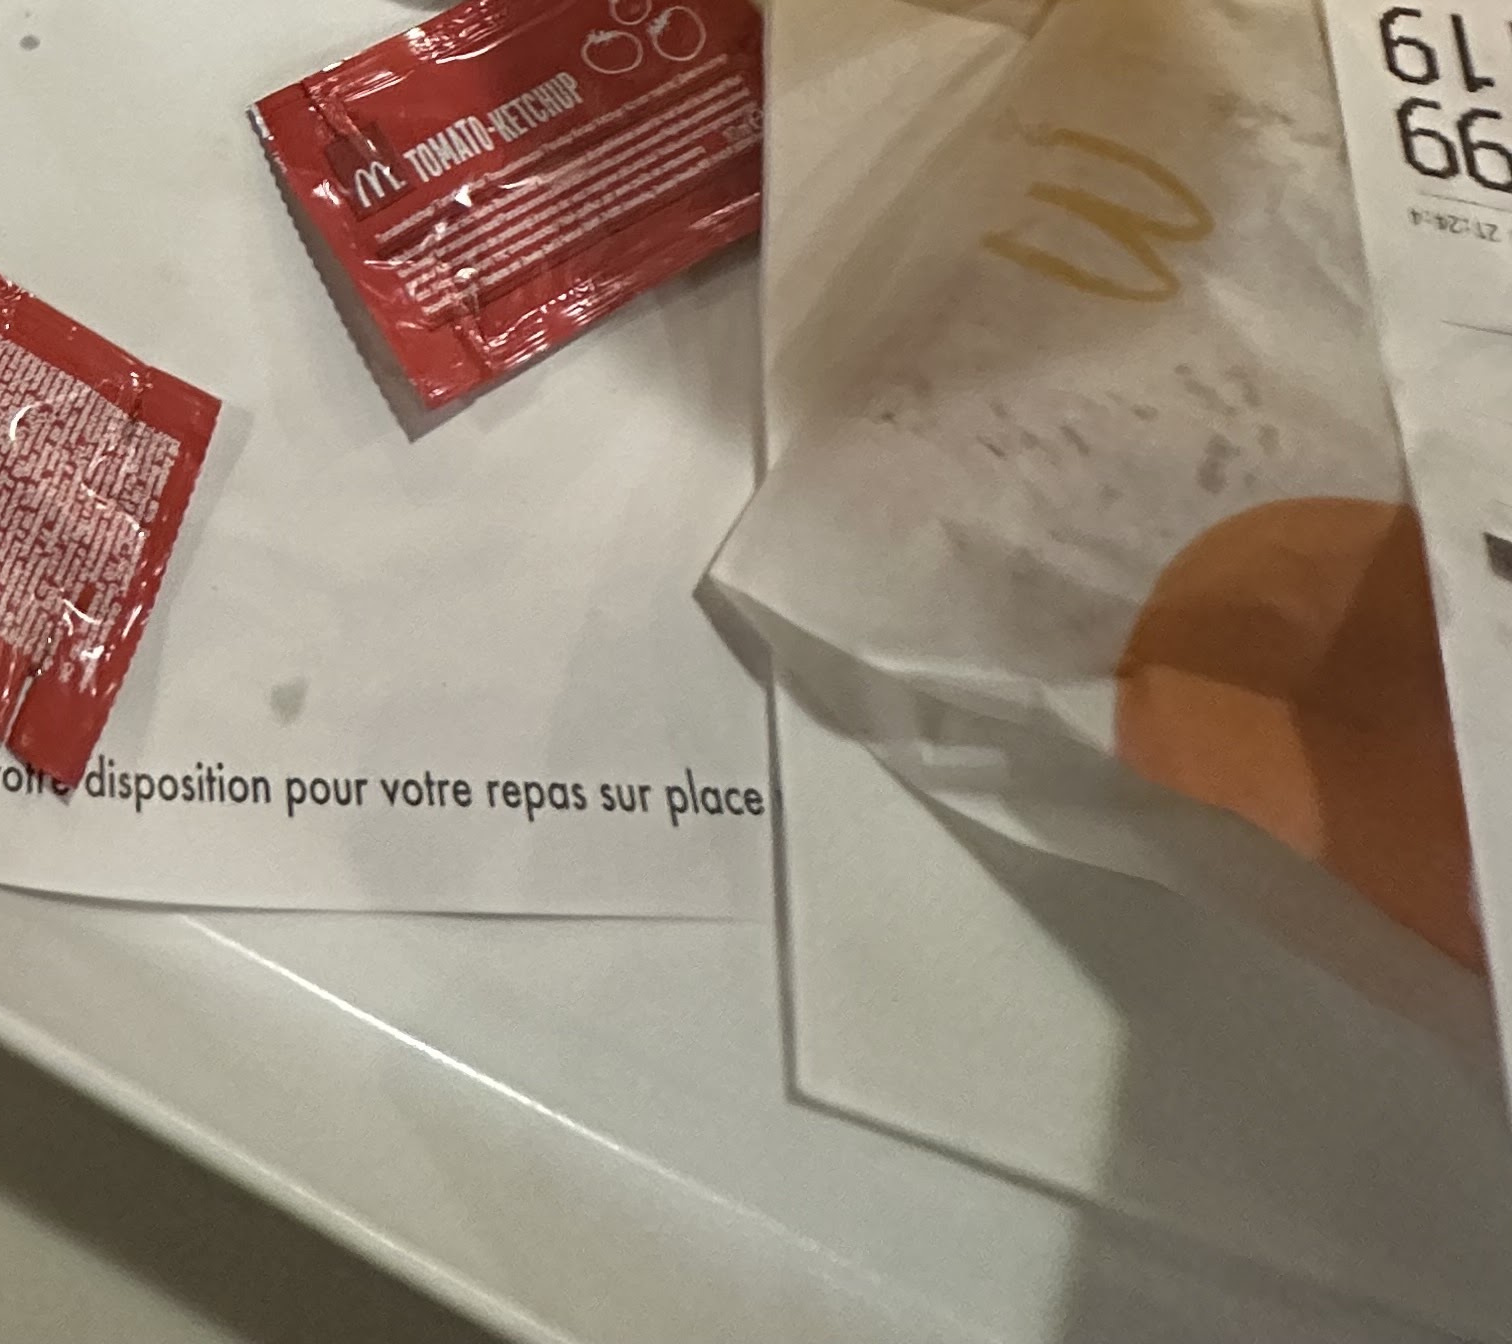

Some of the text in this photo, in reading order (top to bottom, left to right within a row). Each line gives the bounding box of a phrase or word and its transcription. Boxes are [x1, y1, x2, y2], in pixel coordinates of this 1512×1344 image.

[1379, 6, 1512, 93] 19
[404, 70, 584, 183] TOMATO-KETCHUP
[85, 753, 272, 813] disposition
[286, 773, 369, 816] pour
[386, 769, 473, 810] votre
[487, 778, 589, 823] repas
[599, 778, 651, 814] sur
[666, 767, 766, 827] place
